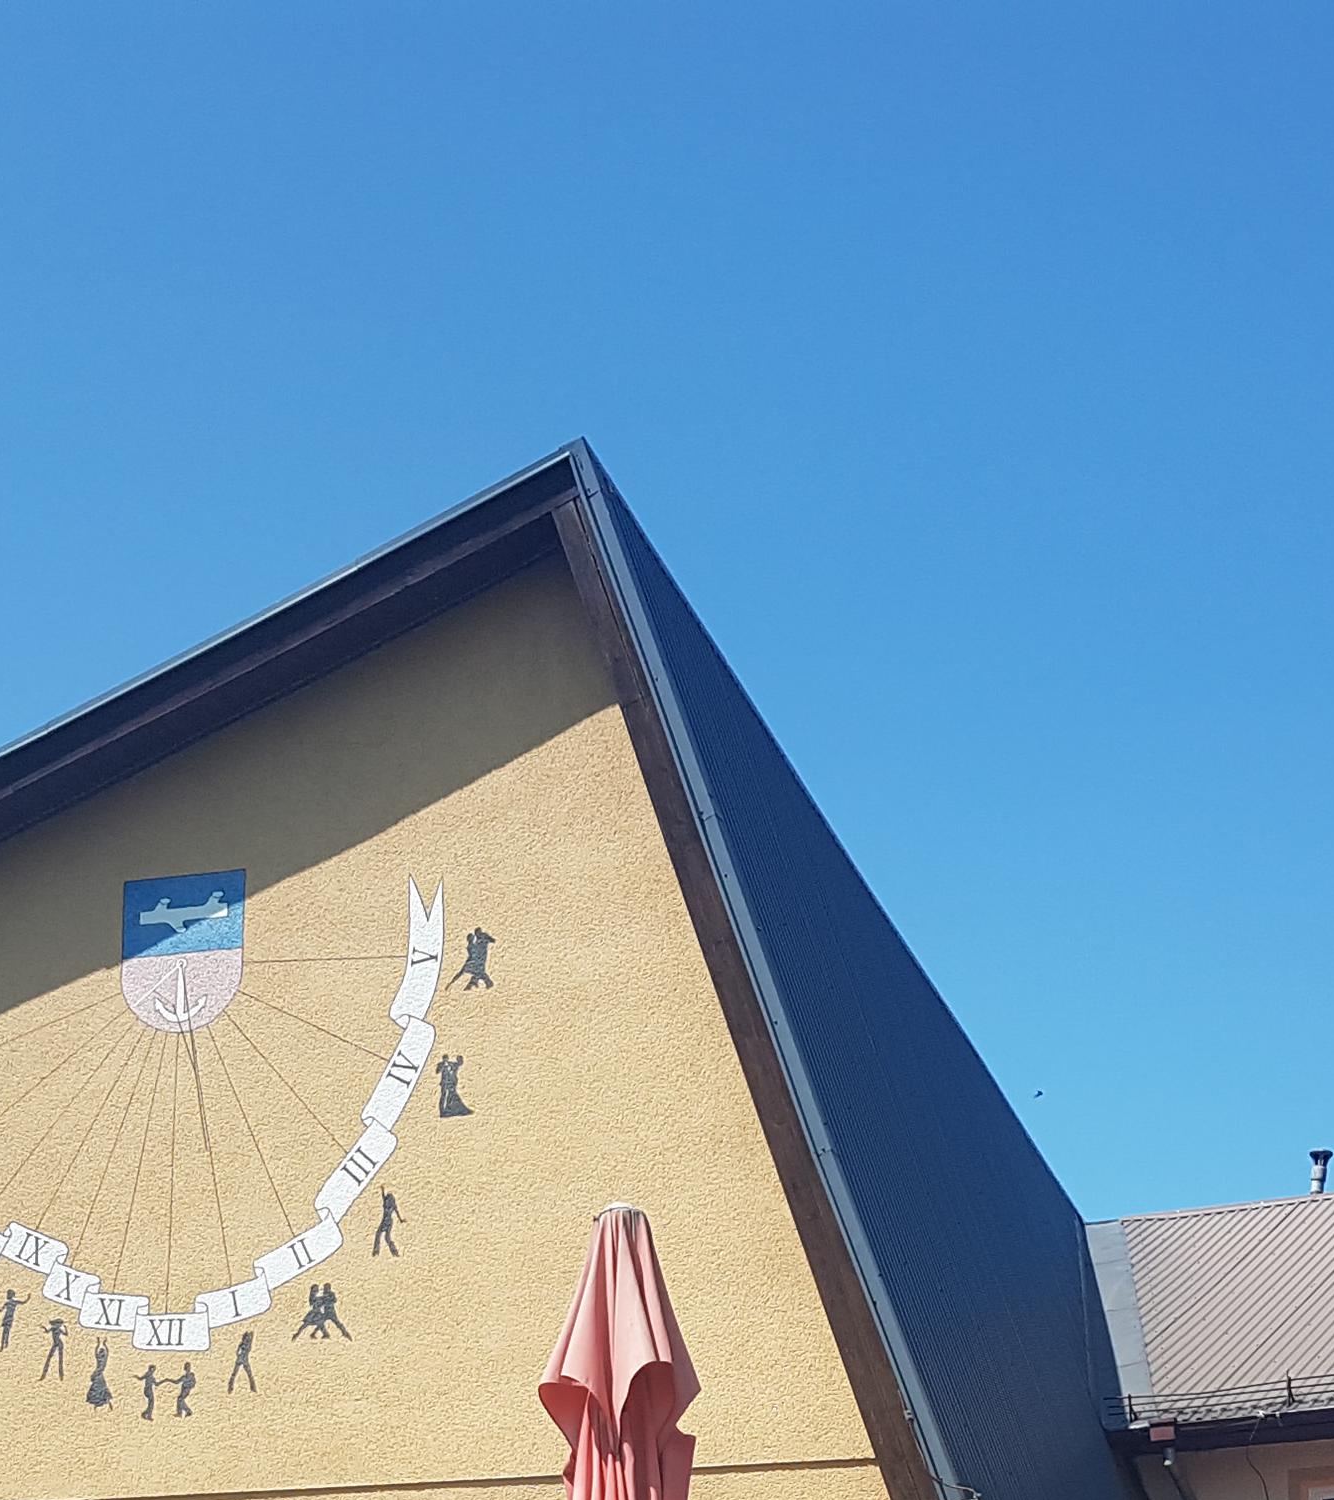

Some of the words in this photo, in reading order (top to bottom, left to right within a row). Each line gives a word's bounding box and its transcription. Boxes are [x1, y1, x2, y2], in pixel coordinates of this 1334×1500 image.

[14, 1231, 50, 1268] IX
[55, 1271, 81, 1302] X
[95, 1297, 126, 1327] XI
[146, 1318, 187, 1347] XII
[228, 1290, 244, 1319] I
[287, 1238, 315, 1270] II
[340, 1145, 379, 1187] III
[385, 1049, 420, 1089] IV
[410, 946, 439, 968] V
